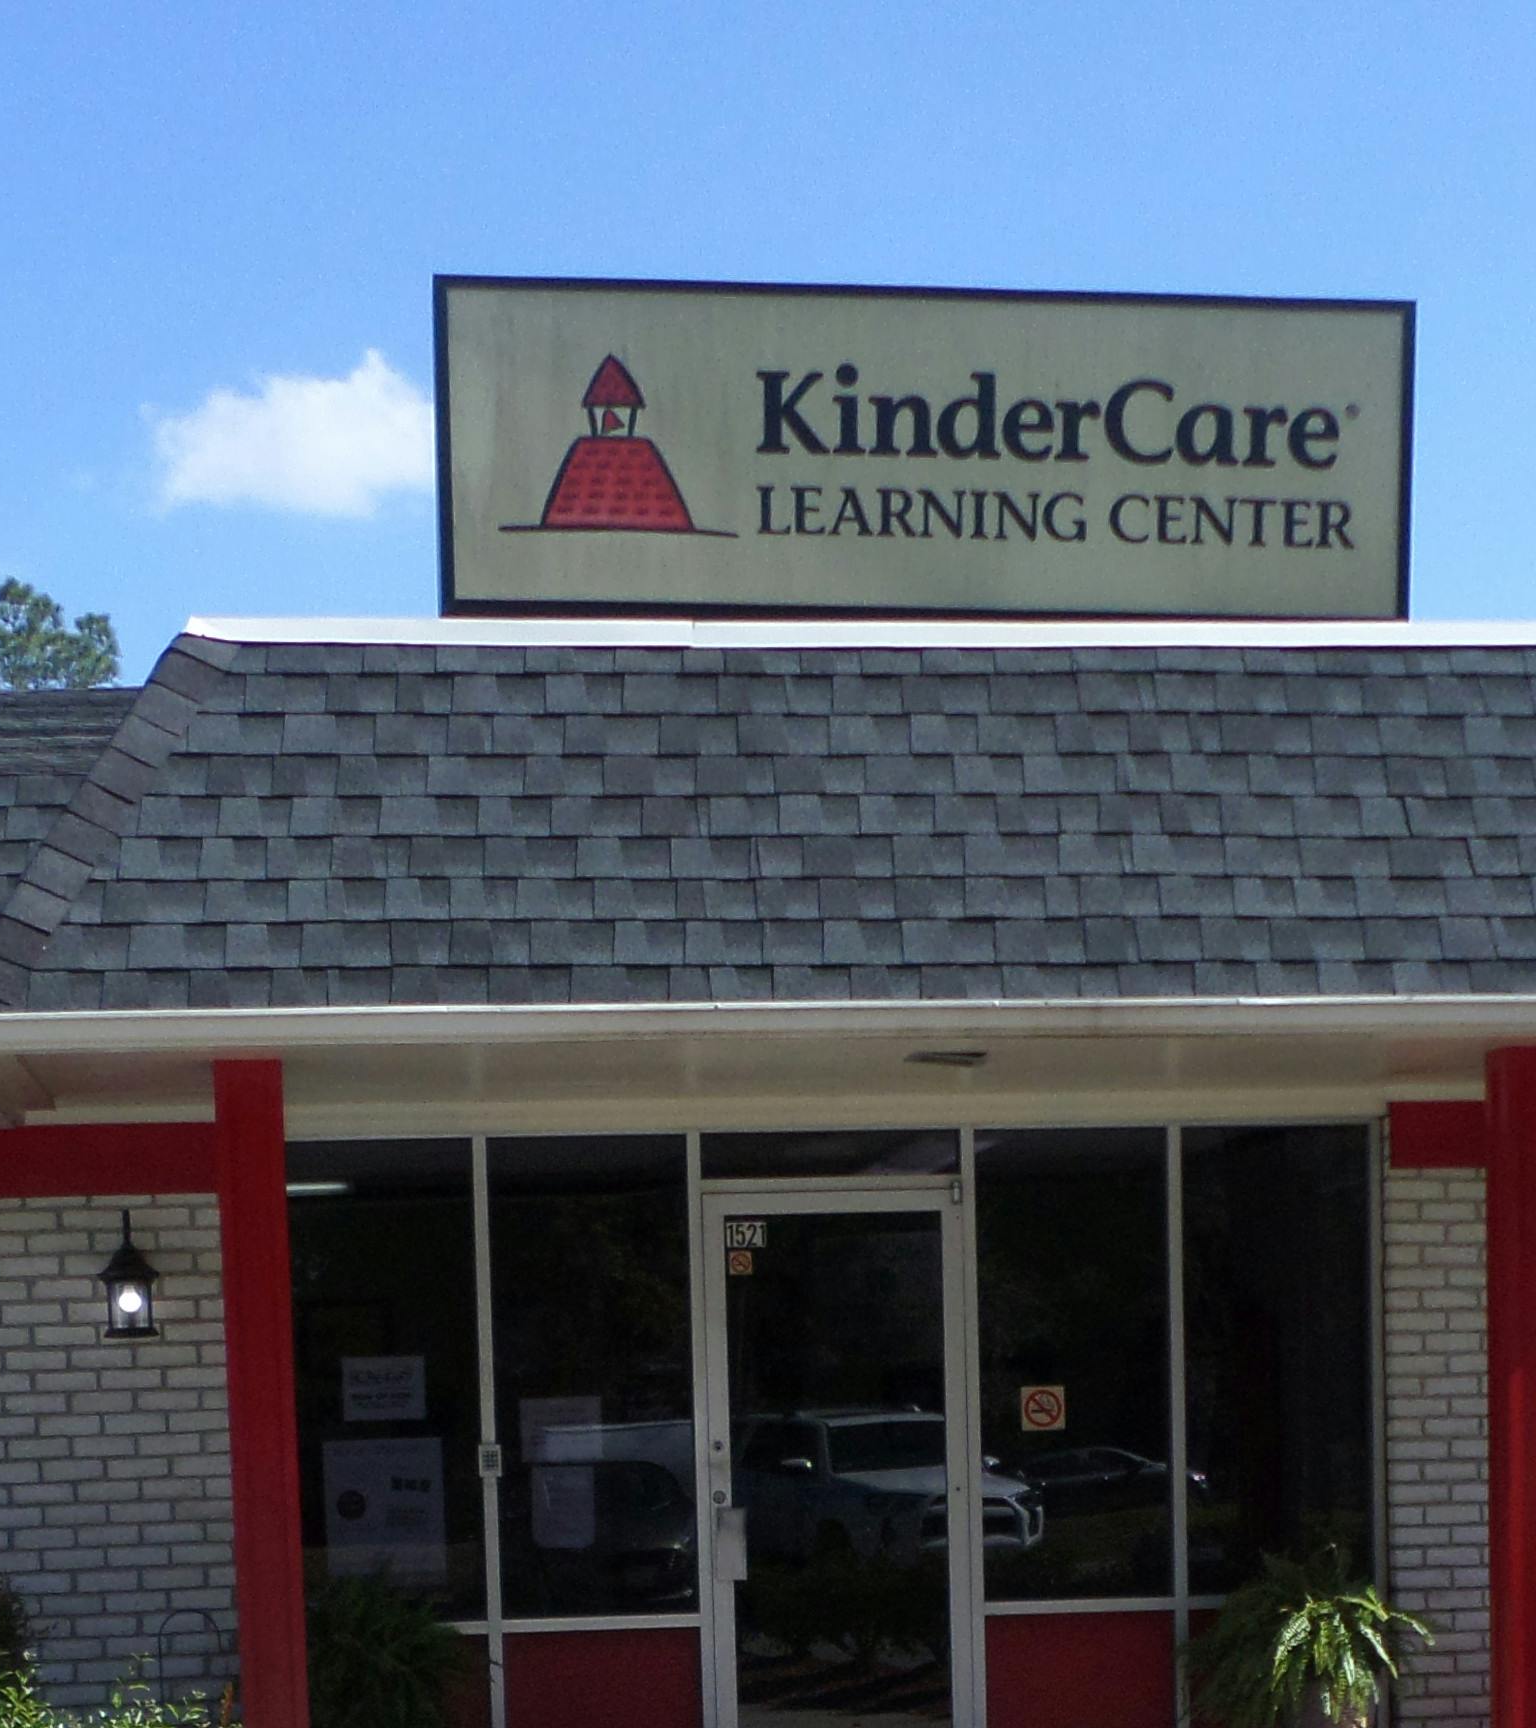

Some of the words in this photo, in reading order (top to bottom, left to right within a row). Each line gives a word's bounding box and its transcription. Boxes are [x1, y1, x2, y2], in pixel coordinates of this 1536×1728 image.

[756, 363, 1341, 470] KinderCare
[756, 485, 1088, 543] LEARNING
[1109, 493, 1355, 550] CENTER
[728, 1223, 767, 1248] 1521
